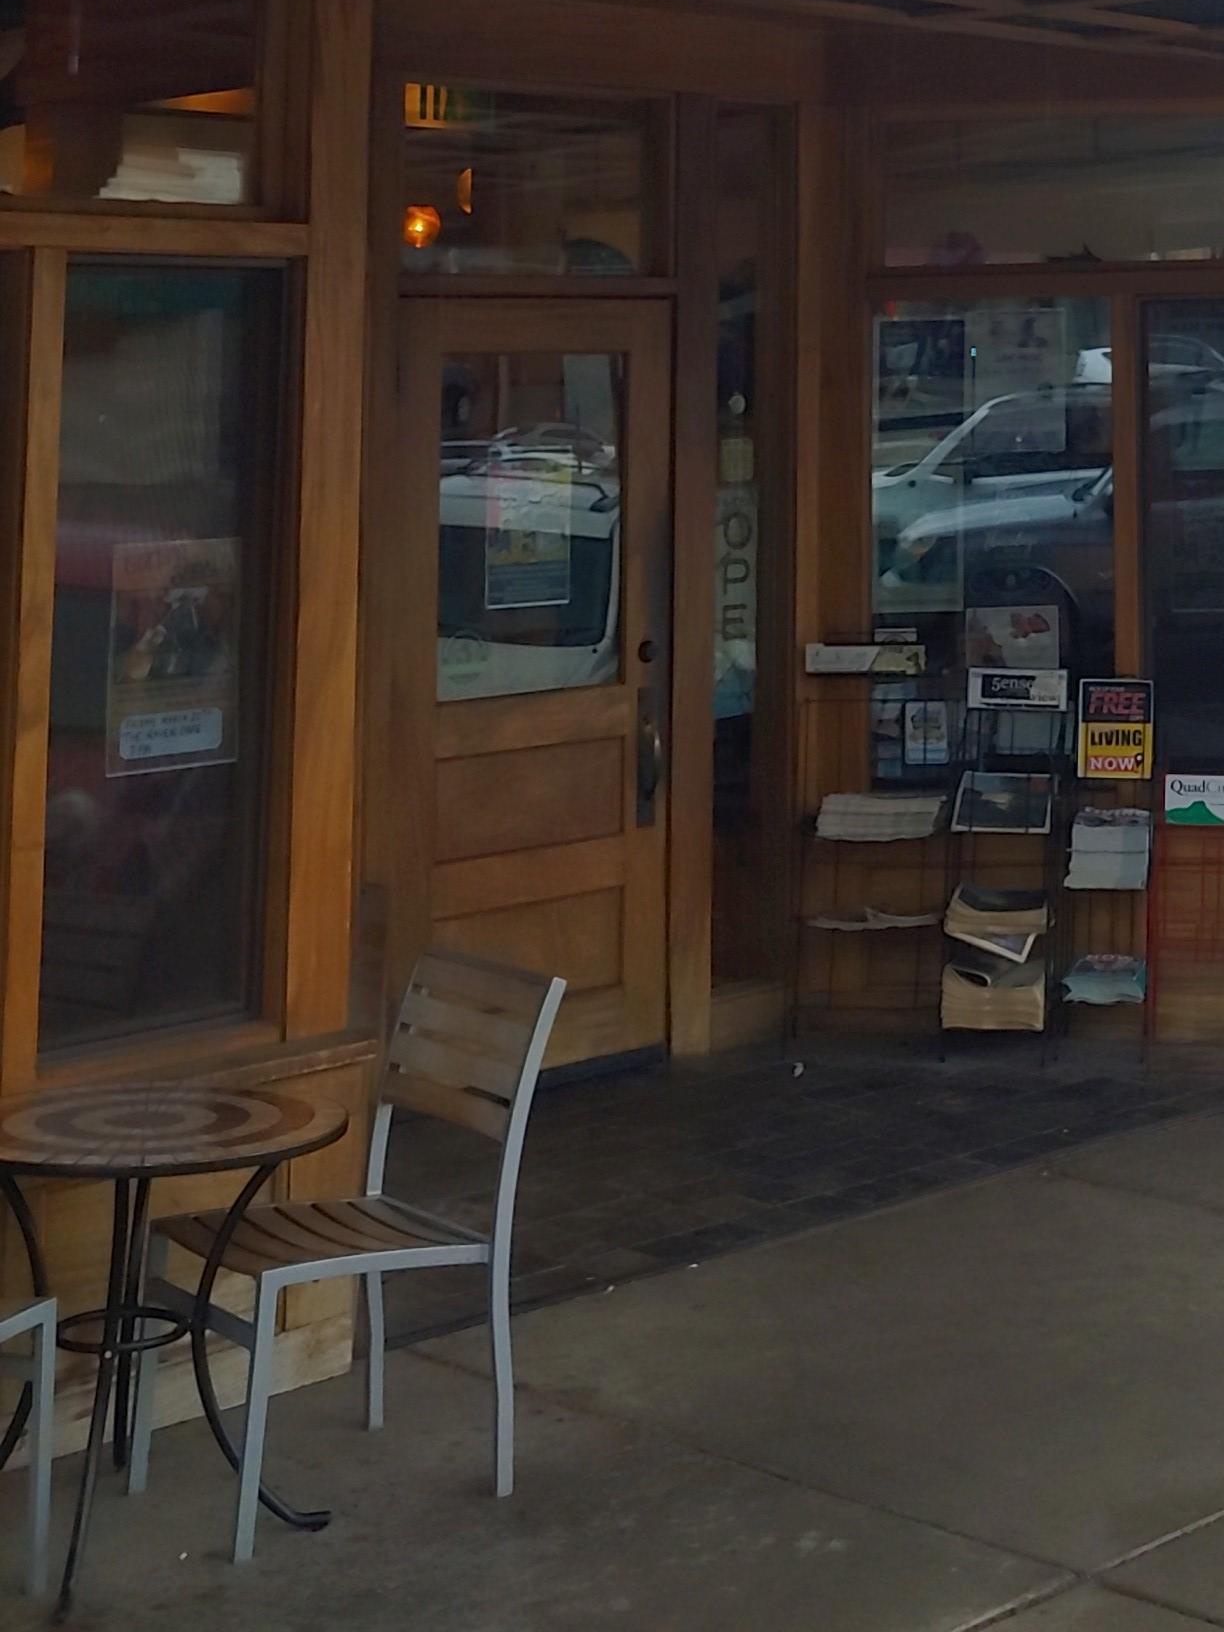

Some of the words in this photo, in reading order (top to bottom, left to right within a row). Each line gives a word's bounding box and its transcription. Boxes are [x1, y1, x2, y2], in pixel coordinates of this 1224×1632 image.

[722, 512, 752, 642] OPE
[1088, 692, 1147, 715] FREE
[1090, 730, 1143, 747] LIVING
[1090, 757, 1136, 770] NOW
